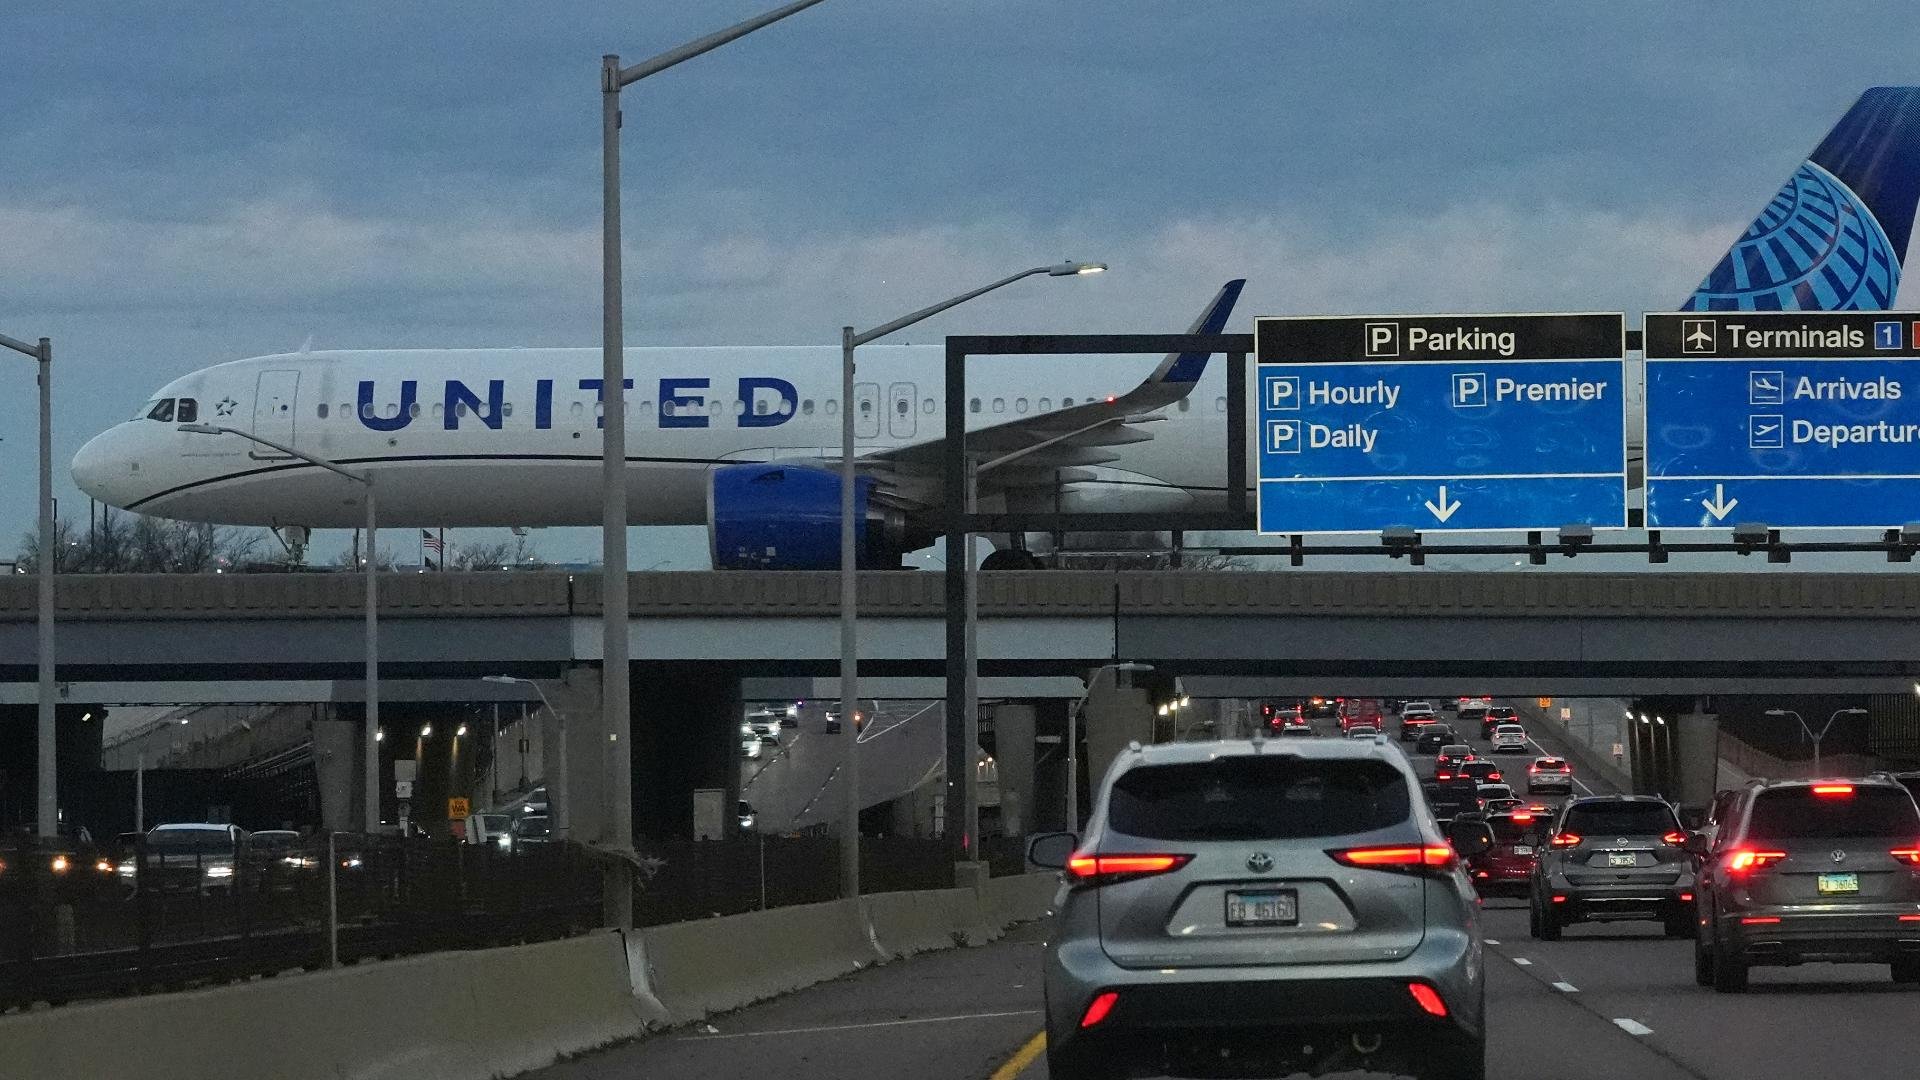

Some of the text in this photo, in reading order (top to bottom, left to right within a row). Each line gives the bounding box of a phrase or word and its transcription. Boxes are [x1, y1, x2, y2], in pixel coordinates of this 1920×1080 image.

[1373, 327, 1515, 355] P Parking
[1726, 325, 1892, 349] Terminals 1
[1273, 380, 1400, 409] P Hourly
[1460, 378, 1607, 402] P Premier
[1794, 376, 1902, 400] Arrivals
[357, 377, 799, 432] UNITED
[1274, 424, 1378, 453] P Daily
[1793, 420, 1920, 449] Departur
